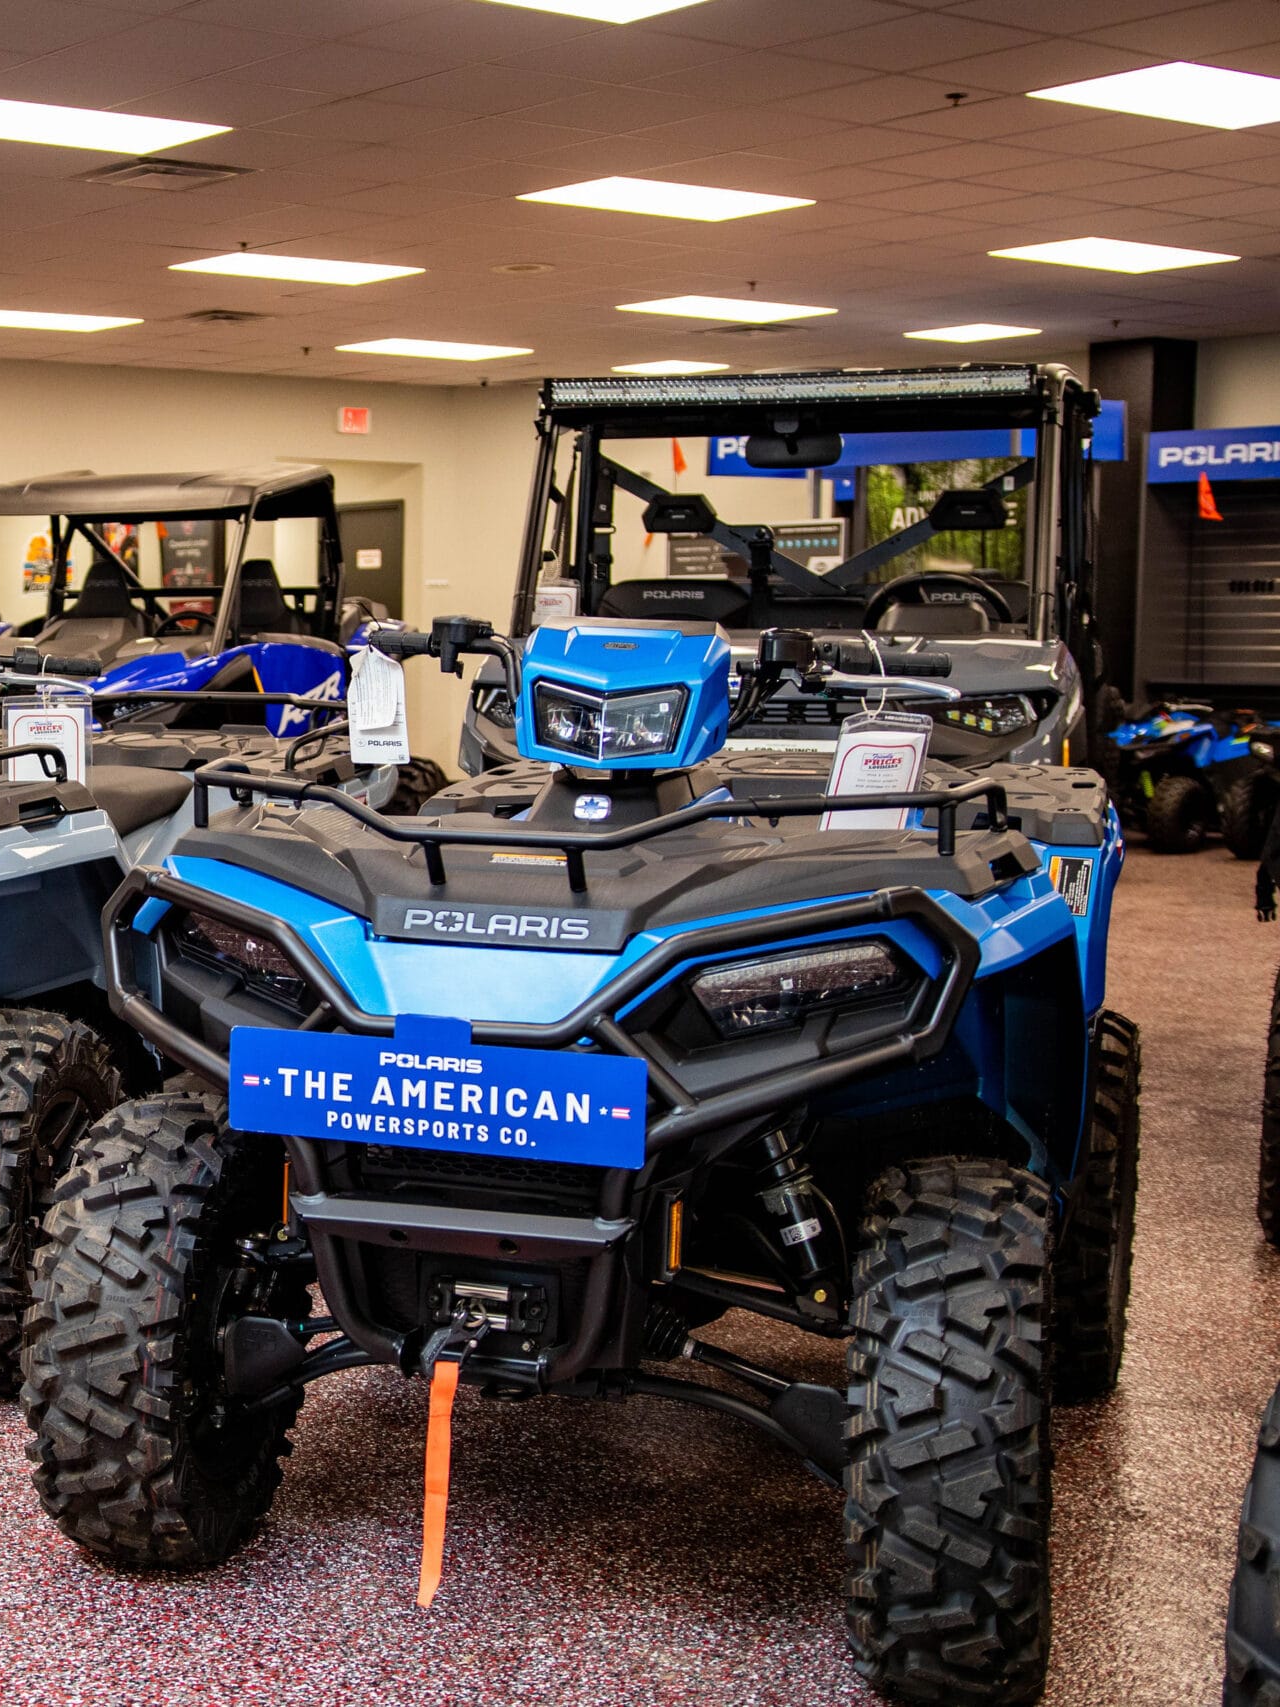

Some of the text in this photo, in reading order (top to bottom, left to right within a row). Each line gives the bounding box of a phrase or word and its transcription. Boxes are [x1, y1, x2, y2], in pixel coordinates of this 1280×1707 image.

[1158, 441, 1280, 468] POLARI
[643, 591, 705, 600] POLARIS
[930, 592, 986, 602] POLAR
[863, 757, 903, 766] PRICES
[403, 908, 590, 941] POLARIS
[379, 1052, 483, 1074] POLARIS
[277, 1067, 591, 1124] THE AMERICAN
[326, 1110, 537, 1148] POWERSPORTS CO.
